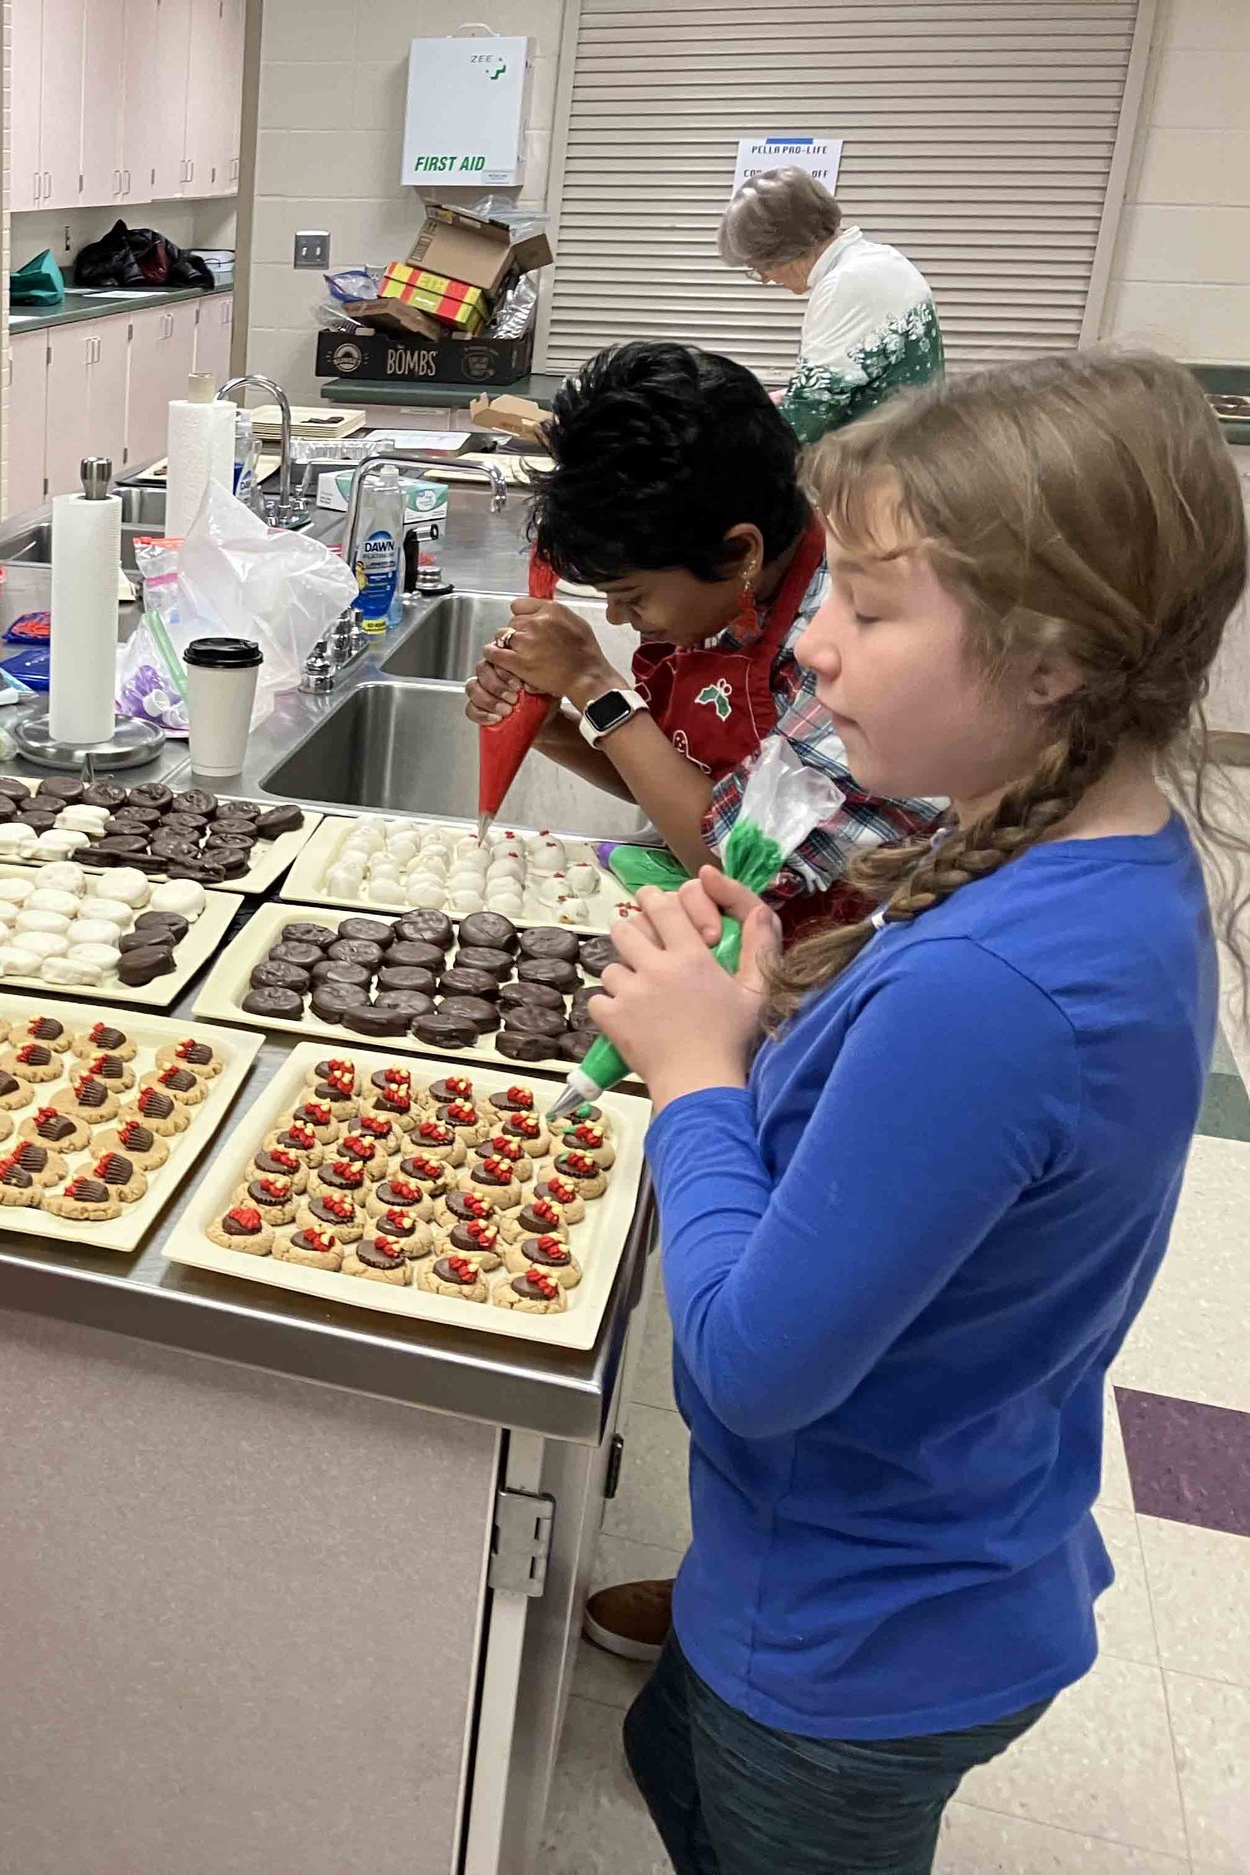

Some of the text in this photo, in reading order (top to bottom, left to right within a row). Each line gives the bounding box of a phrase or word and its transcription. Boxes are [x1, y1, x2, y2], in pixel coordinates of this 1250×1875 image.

[470, 55, 494, 63] ZEE
[751, 145, 827, 155] PELLA PRO-LIFE
[415, 156, 486, 171] FIRST AID
[364, 540, 395, 552] DAWN
